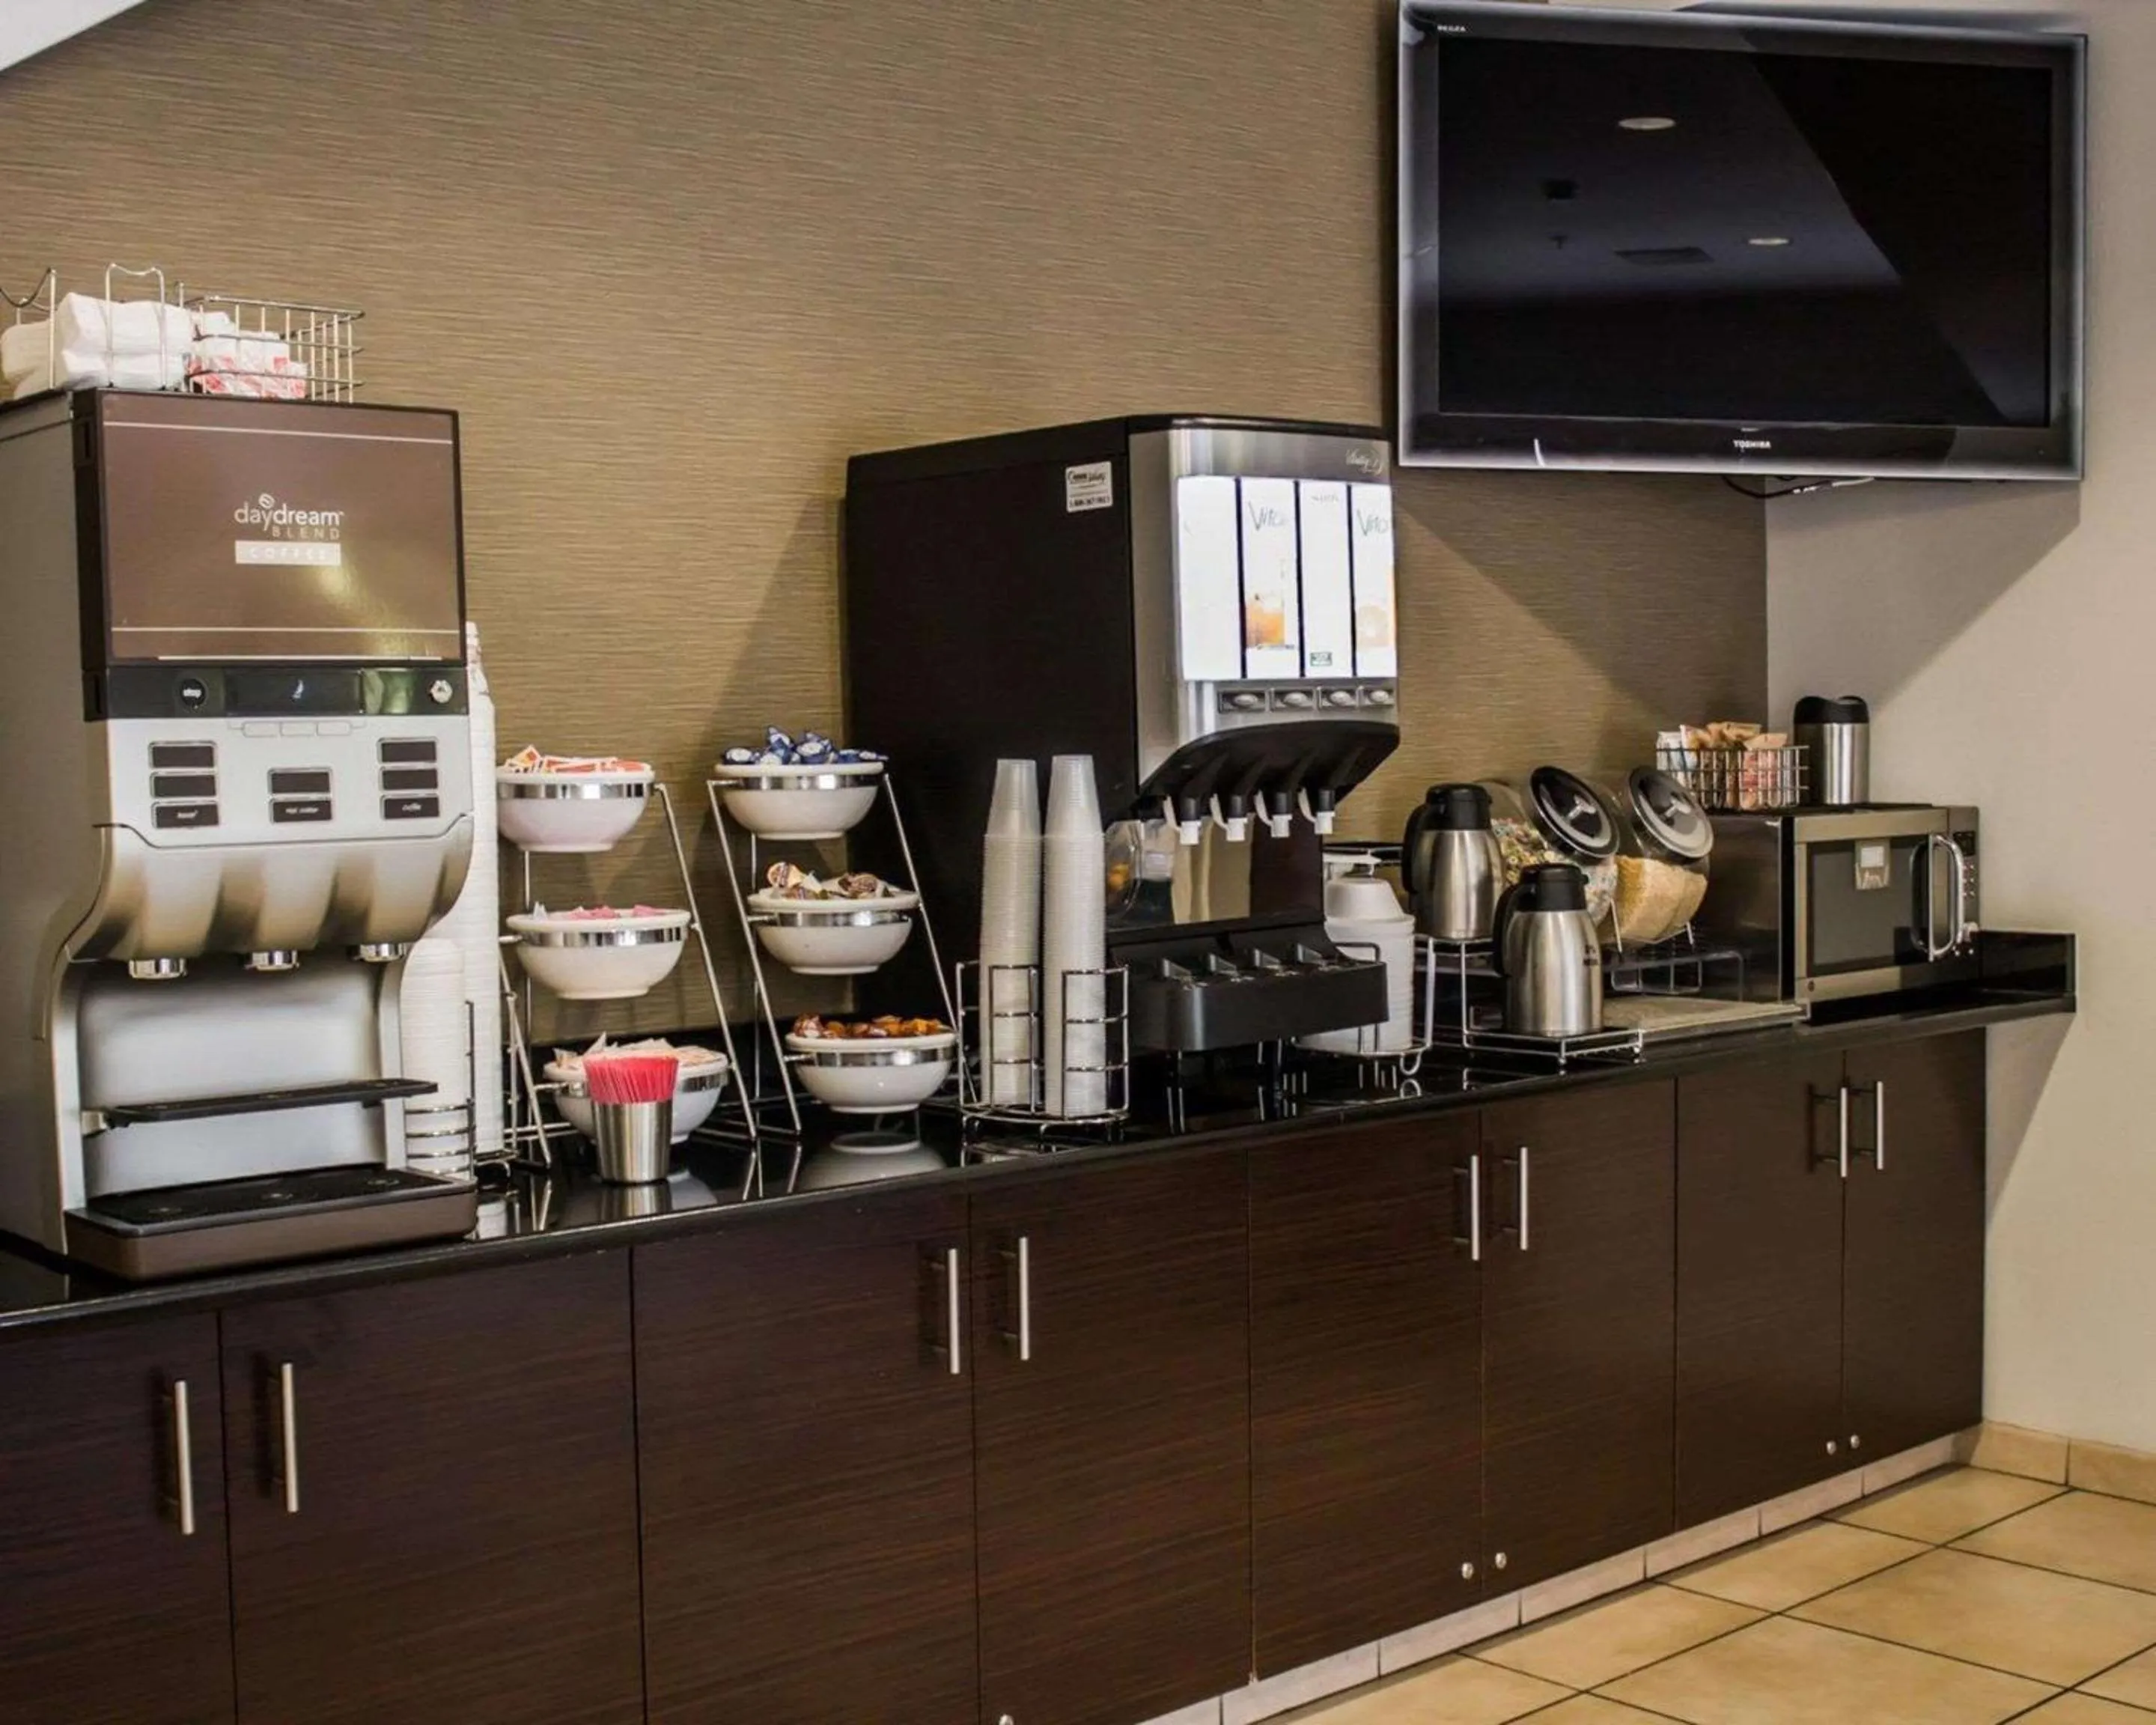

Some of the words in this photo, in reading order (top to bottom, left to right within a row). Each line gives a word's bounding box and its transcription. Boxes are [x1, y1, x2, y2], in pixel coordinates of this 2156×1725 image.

[1733, 439, 1771, 449] TOSHIBA
[234, 501, 341, 531] daydream
[272, 525, 341, 541] BLEND
